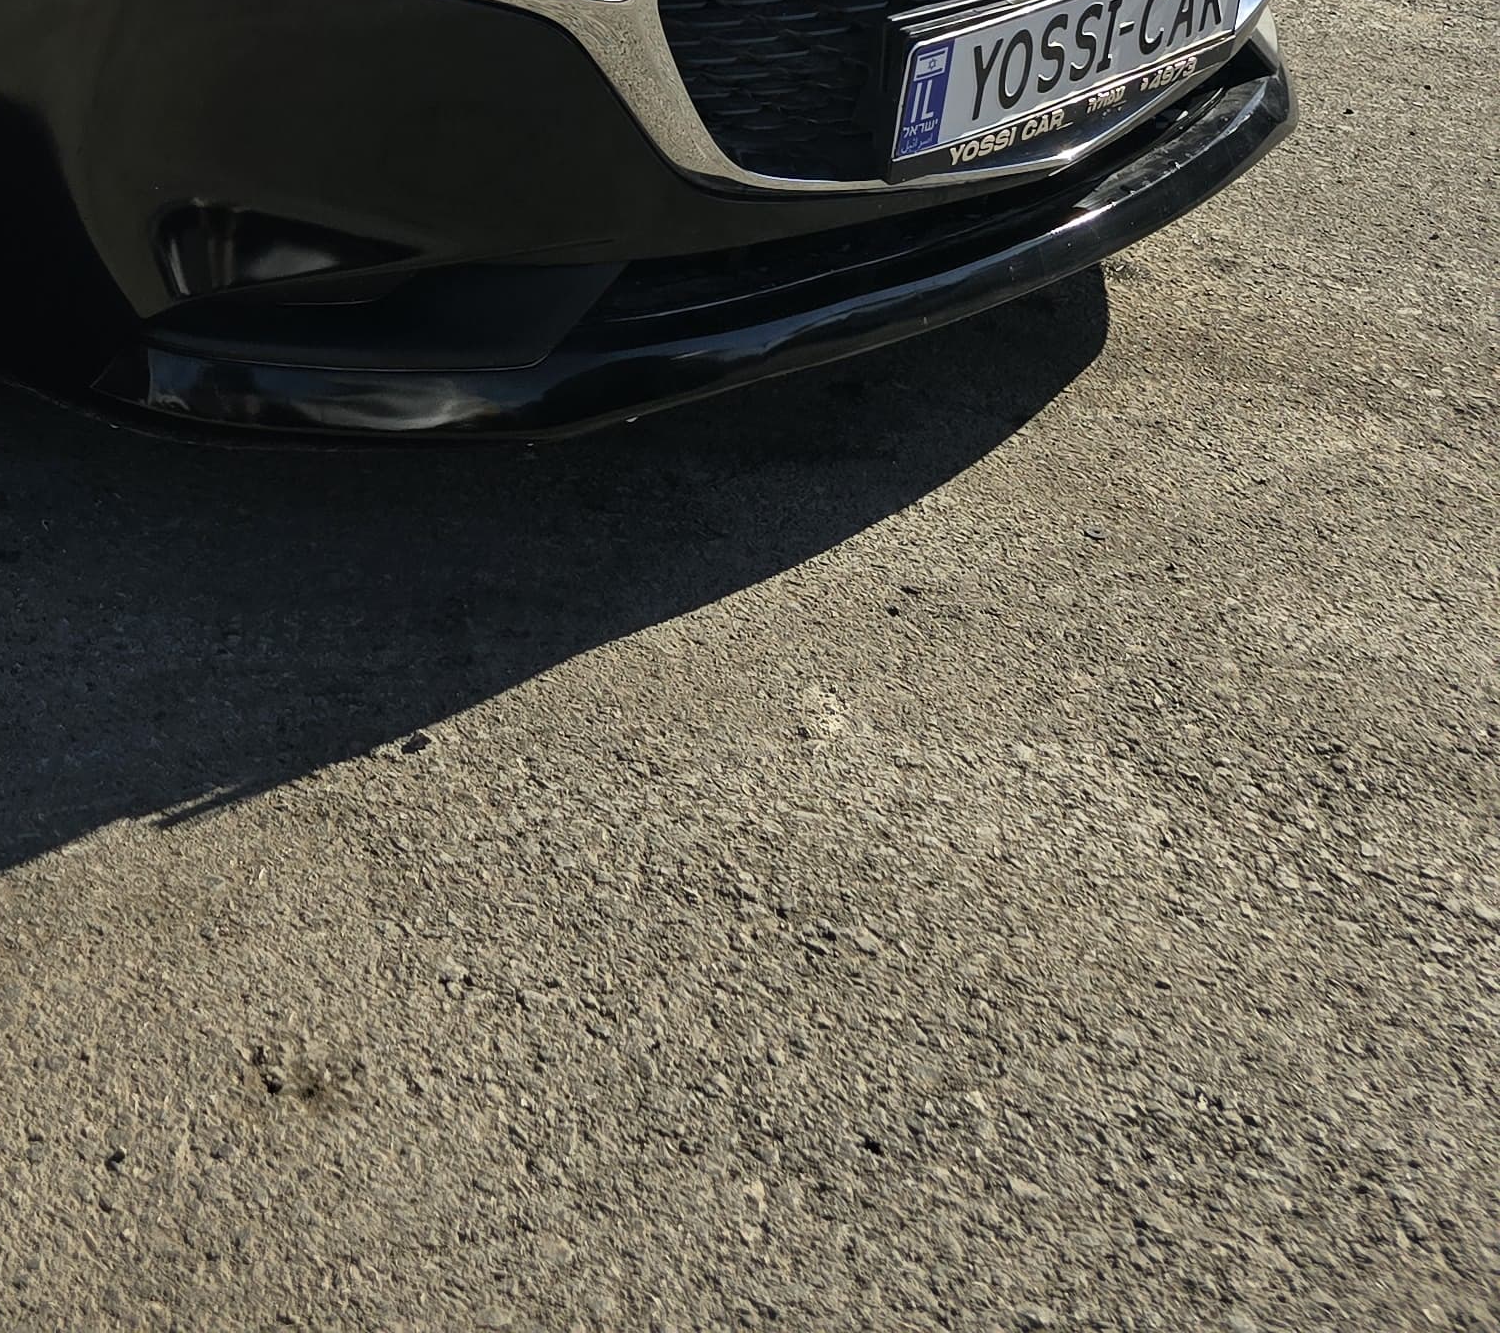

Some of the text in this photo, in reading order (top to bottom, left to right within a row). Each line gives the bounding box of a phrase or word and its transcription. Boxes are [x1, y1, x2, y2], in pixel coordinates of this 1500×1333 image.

[910, 79, 934, 123] IL
[902, 118, 939, 139] ישראל
[949, 108, 1066, 166] YOSSI CAR
